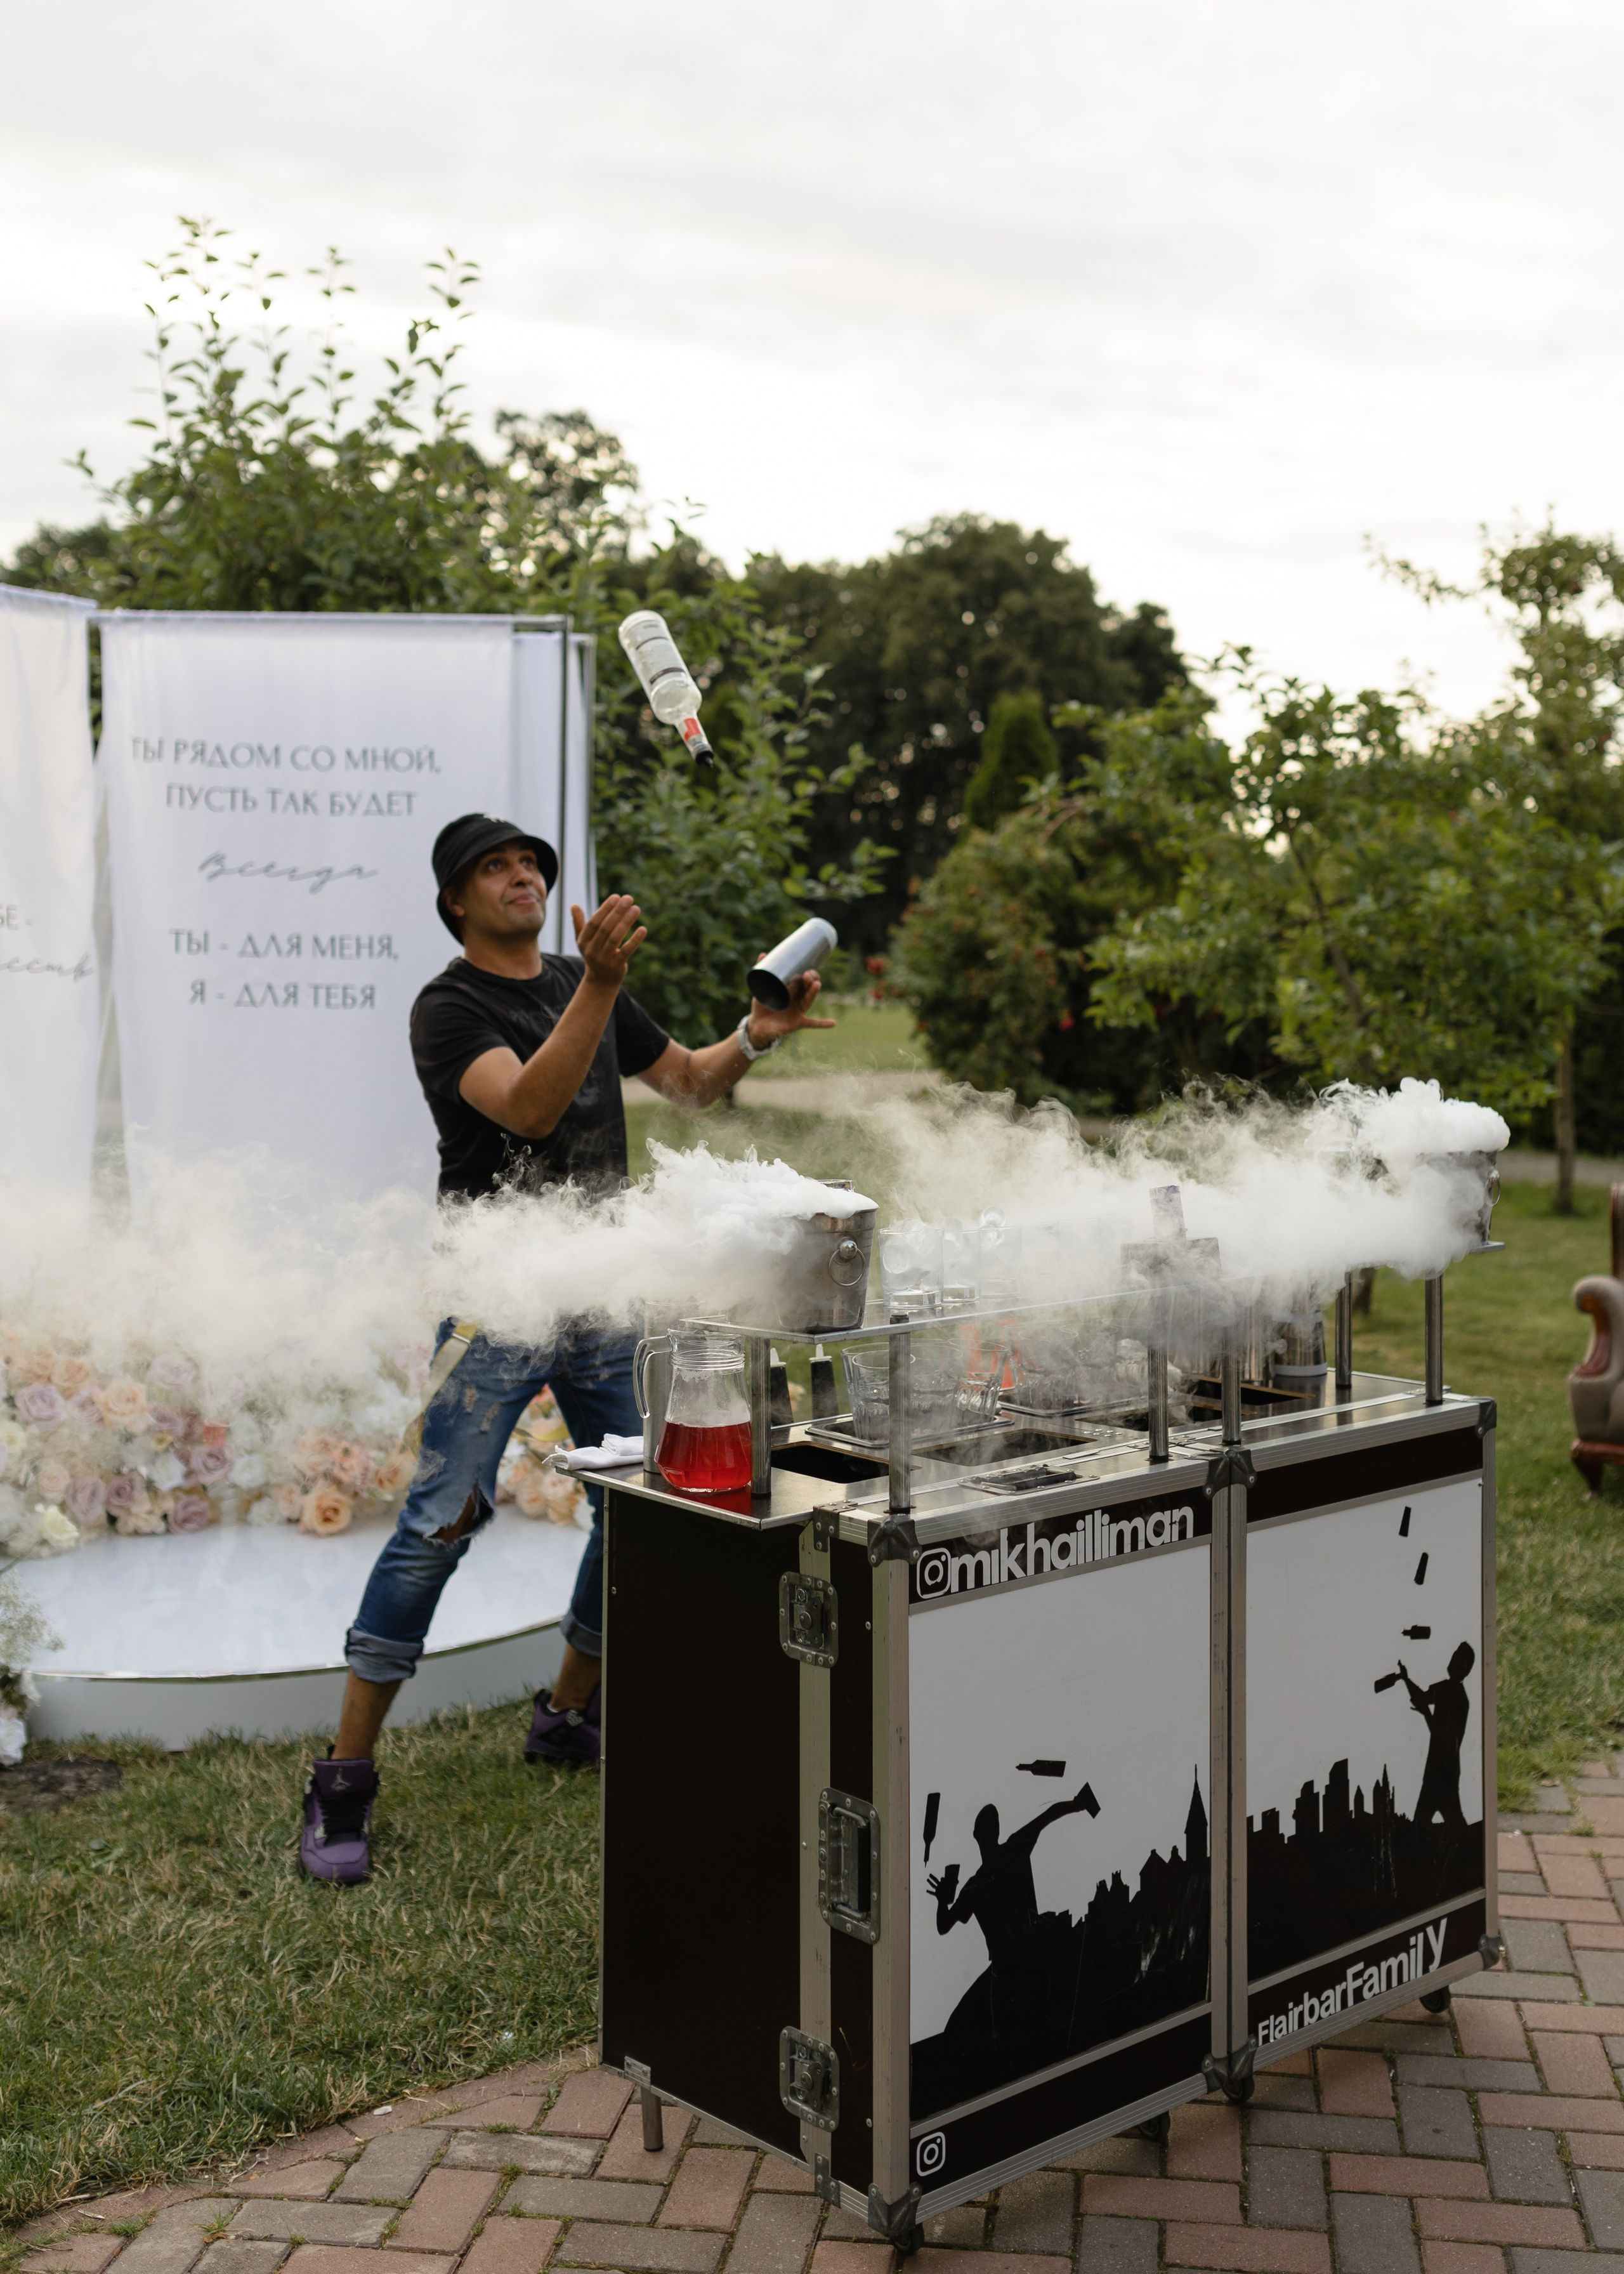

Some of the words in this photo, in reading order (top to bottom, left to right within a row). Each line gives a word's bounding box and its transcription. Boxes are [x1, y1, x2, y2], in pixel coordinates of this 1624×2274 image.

[130, 735, 164, 763] ТЫ
[174, 738, 281, 769] РЯДОМ
[290, 745, 336, 772] СО
[344, 744, 442, 773] МНОЙ,
[166, 781, 259, 813] ПУСТЬ
[265, 786, 320, 817] ТАК
[329, 790, 419, 817] БУДЕТ
[169, 928, 210, 956] ТЫ
[237, 932, 302, 959] ДЛЯ
[311, 933, 400, 961] МЕНЯ,
[188, 978, 206, 1006] Я
[233, 982, 299, 1008] ДЛЯ
[307, 982, 376, 1010] ТЕБЯ
